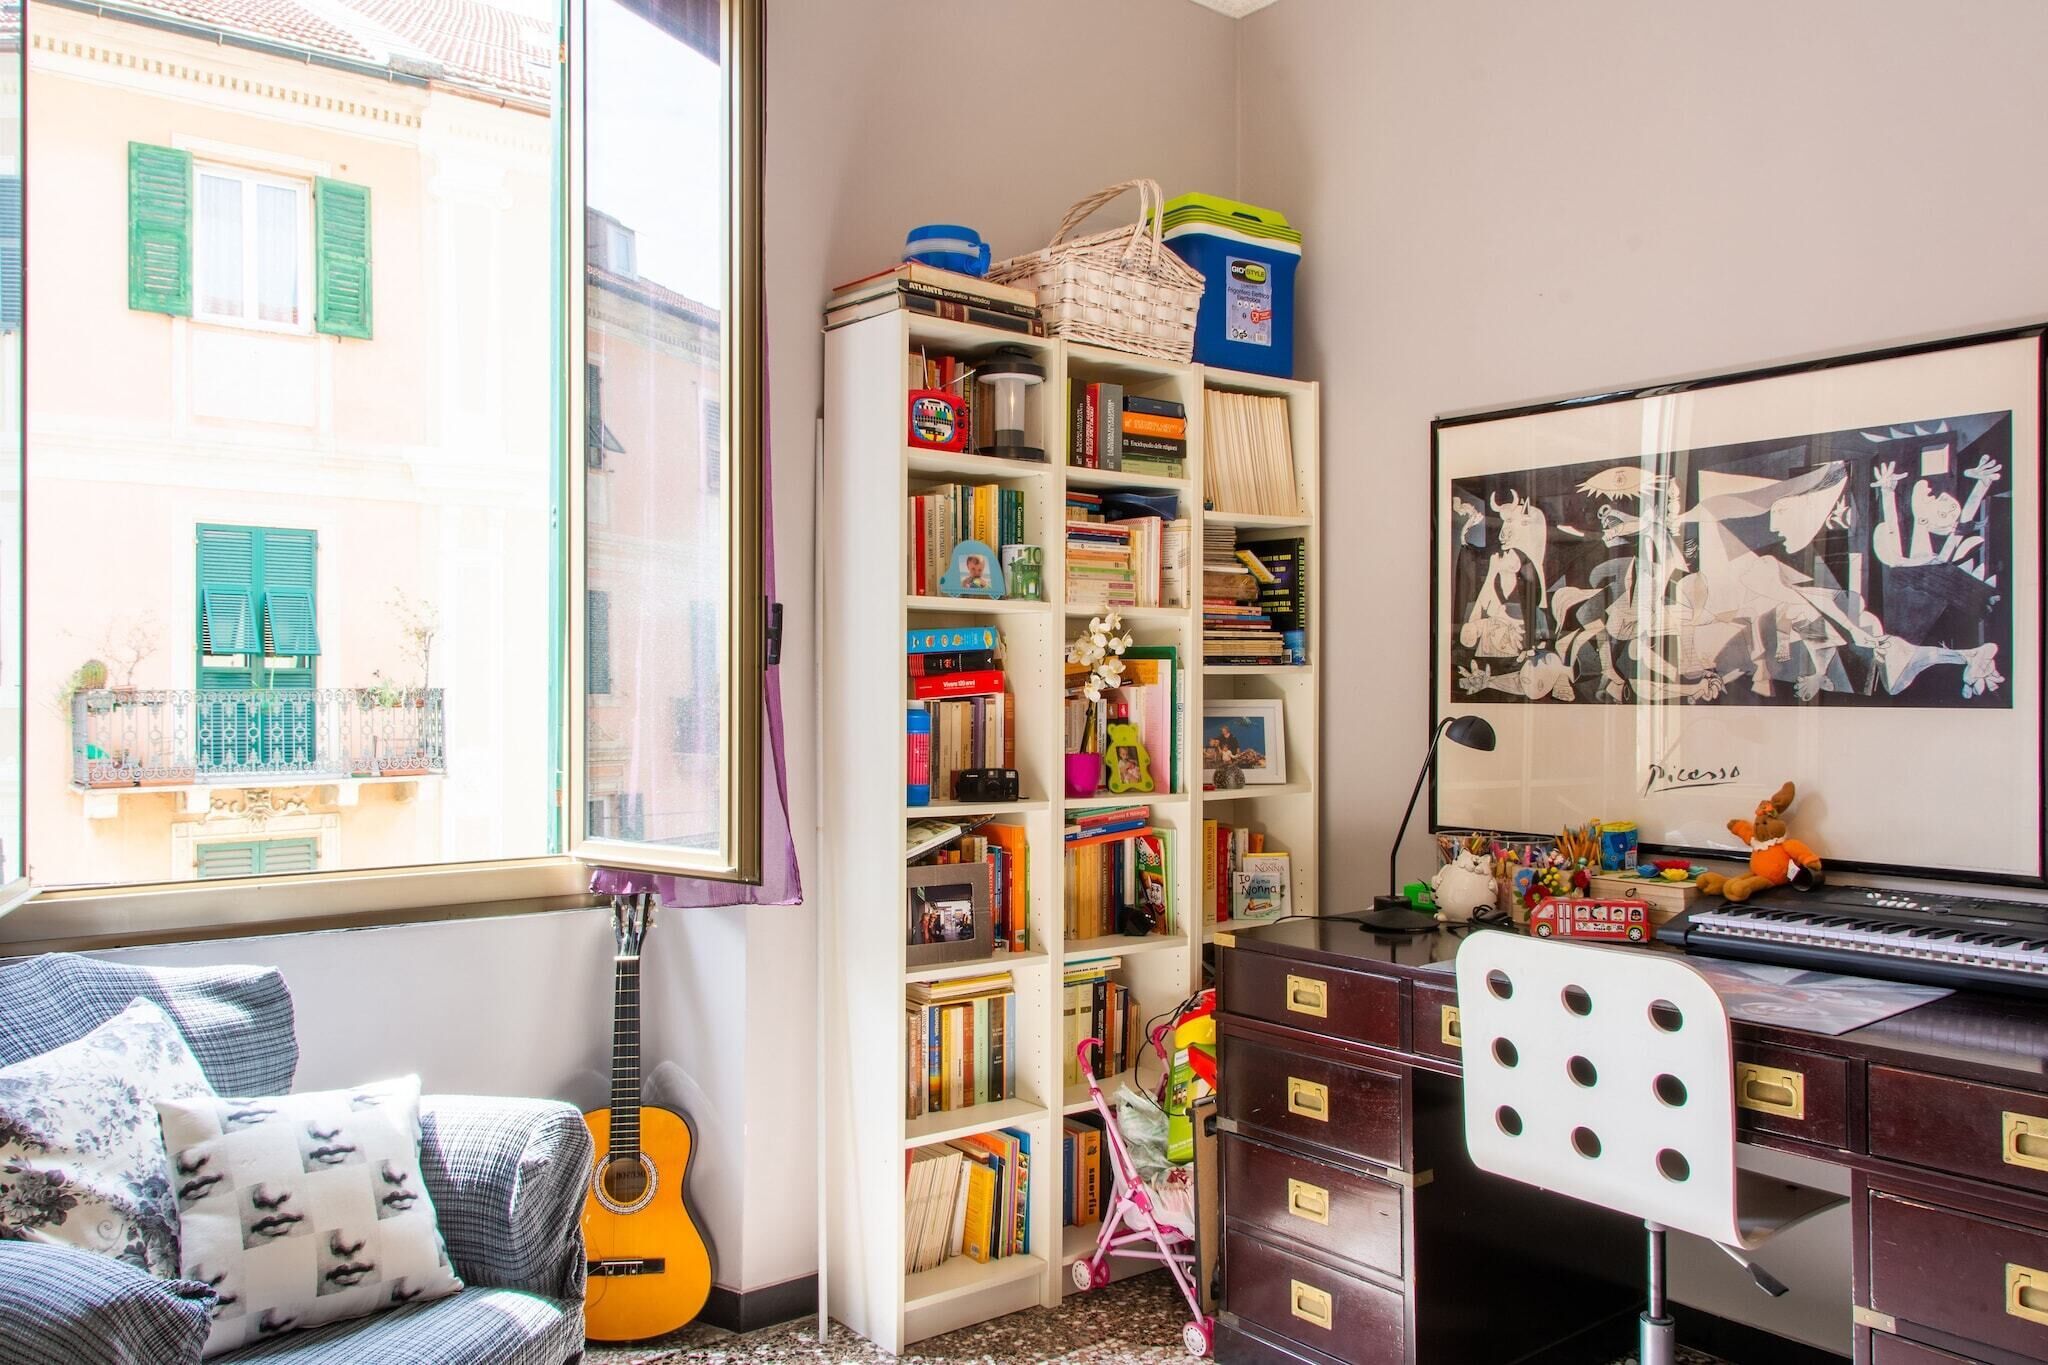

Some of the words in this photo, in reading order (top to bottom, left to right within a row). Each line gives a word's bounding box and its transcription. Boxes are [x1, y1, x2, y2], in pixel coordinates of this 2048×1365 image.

[1246, 268, 1265, 278] STYLE
[908, 281, 943, 296] ATLANTE
[1024, 546, 1041, 565] 10
[1643, 763, 1740, 798] Picasso
[1255, 863, 1285, 873] NONNA
[1238, 874, 1251, 885] Io
[1241, 885, 1277, 896] Nonna
[1088, 1167, 1096, 1216] smorfia
